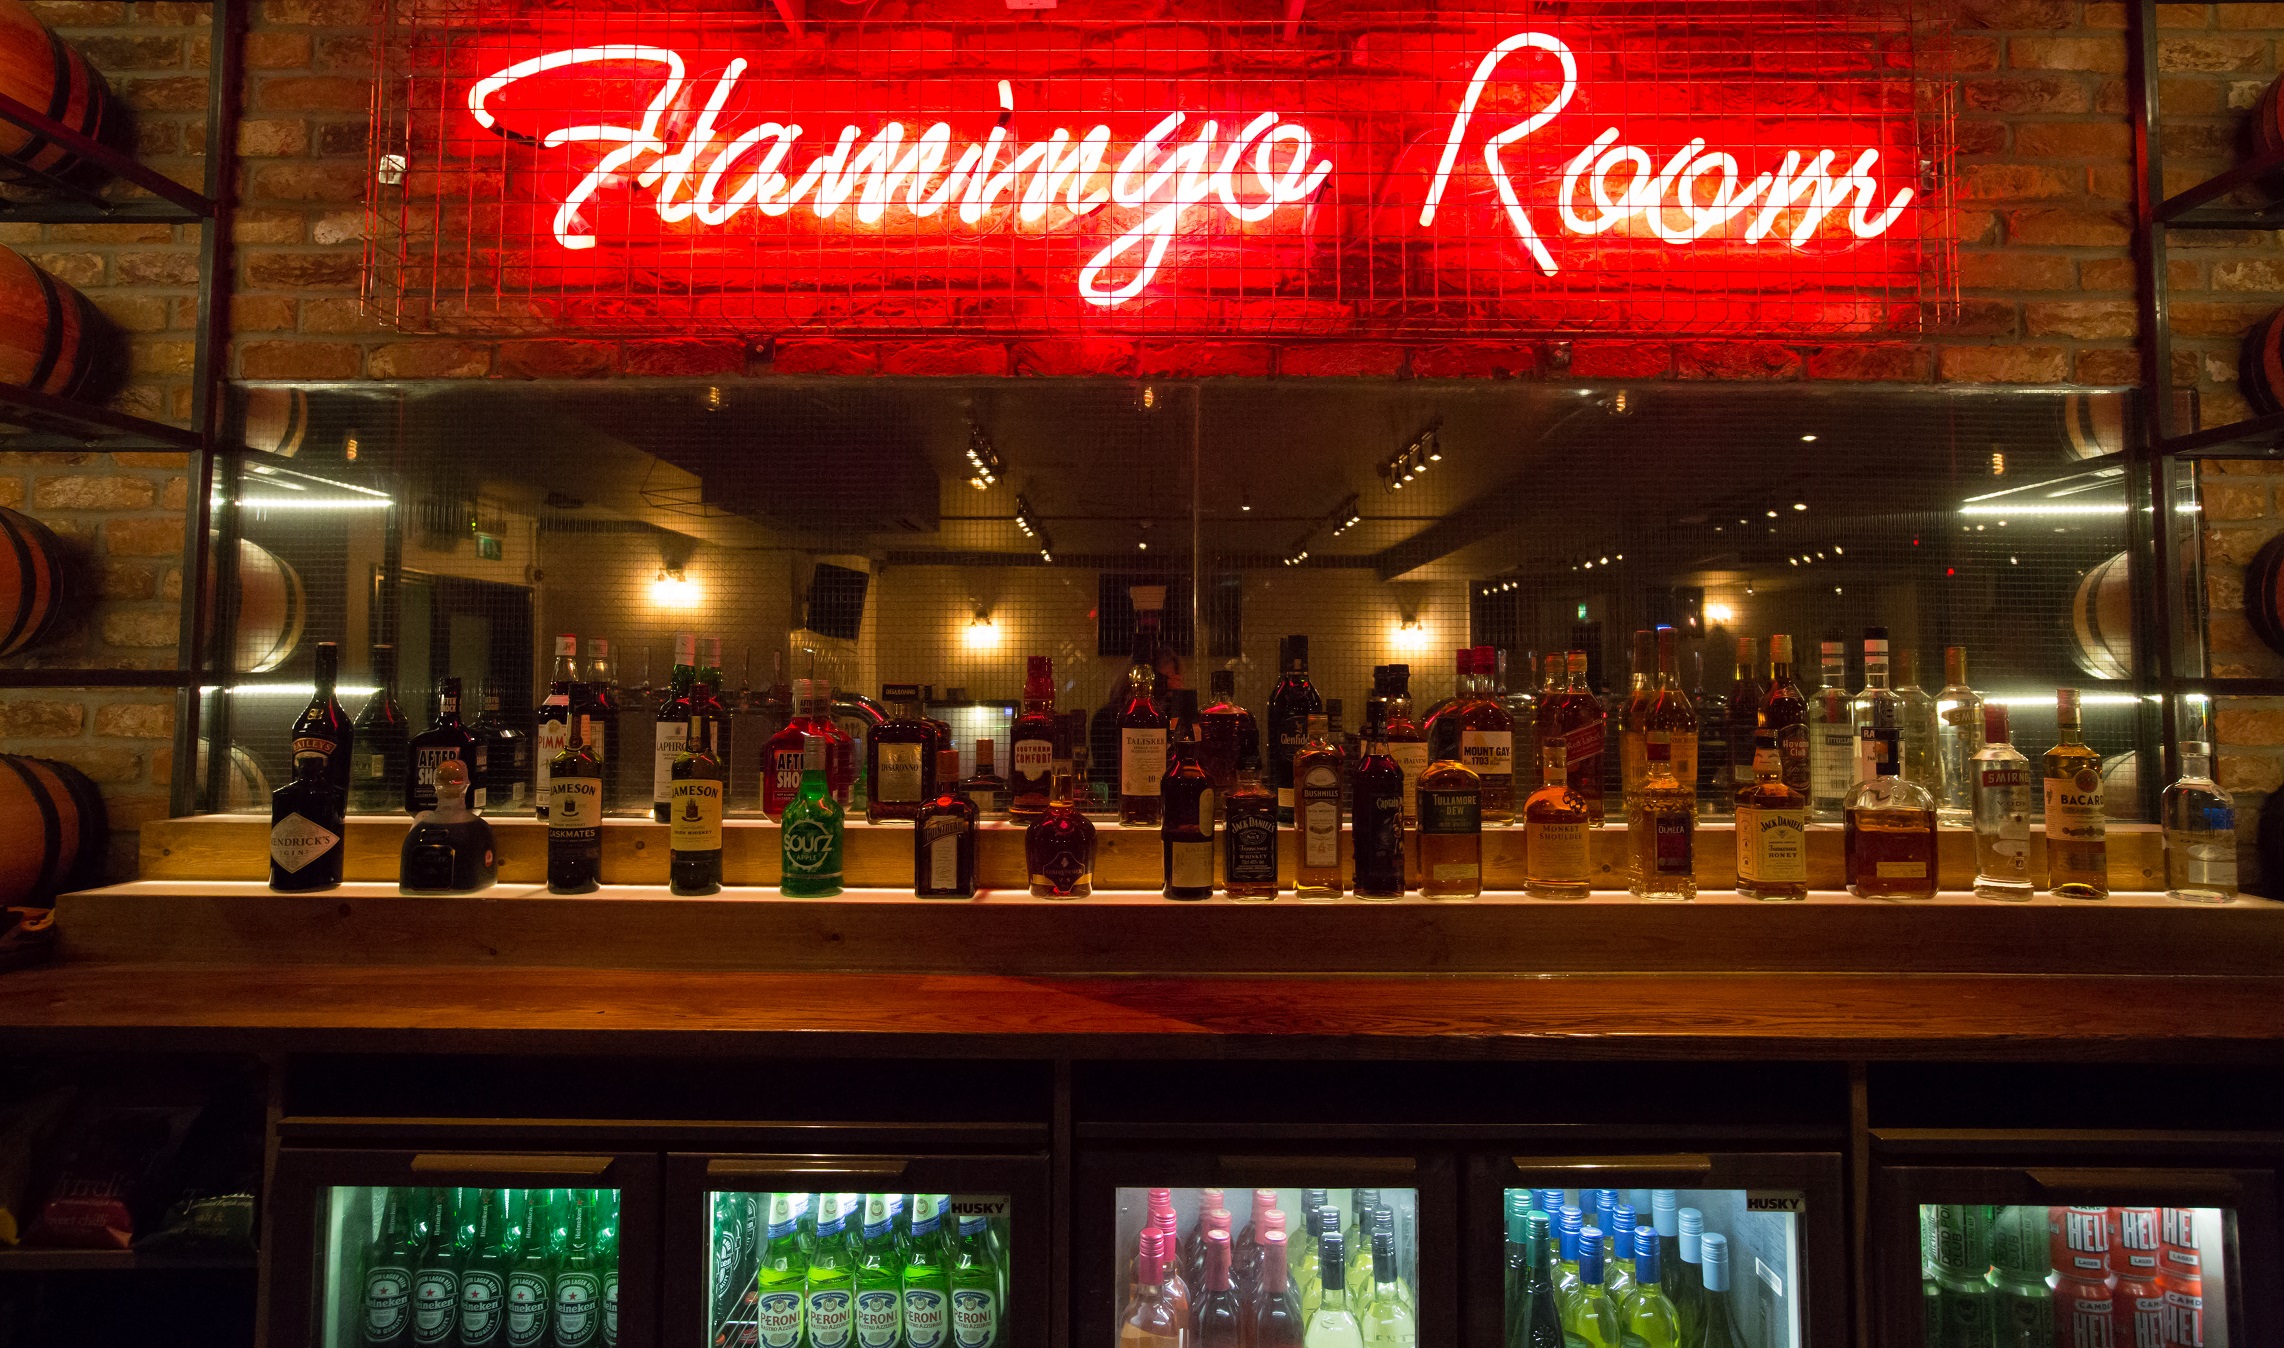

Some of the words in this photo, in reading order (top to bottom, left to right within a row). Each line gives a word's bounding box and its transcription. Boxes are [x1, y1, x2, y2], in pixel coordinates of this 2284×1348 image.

[467, 43, 1334, 306] Flamingo
[1418, 31, 1915, 277] Room
[538, 733, 566, 749] PIMM'
[1126, 737, 1165, 745] TALISKER
[1280, 733, 1310, 745] Glenfidd
[657, 741, 687, 752] LAPHRO
[1464, 747, 1494, 756] MOUNT
[1495, 747, 1510, 756] GAY
[777, 753, 804, 770] AFT
[1471, 757, 1489, 765] 1703
[881, 763, 919, 772] DISARONNO
[776, 771, 801, 788] SHO
[1988, 772, 2029, 784] SMIRNO
[550, 783, 596, 797] JAMESON
[671, 785, 719, 799] JAMESON
[1303, 789, 1339, 798] BUSHMILLS
[1433, 793, 1477, 806] TULLAMORE
[1997, 800, 2028, 808] VODK
[1446, 806, 1465, 815] DEW
[1231, 820, 1248, 834] JACK
[1657, 825, 1685, 834] OLMECA
[1760, 819, 1778, 833] JACK
[1777, 815, 1804, 833] DANIEL'S
[550, 829, 596, 838] CASKMATES
[1539, 832, 1583, 841] SHOULDER
[952, 1203, 1004, 1213] HUSKY
[1748, 1199, 1800, 1209] HUSKY
[2169, 1294, 2202, 1306] CAMD
[760, 1310, 800, 1326] PERONI
[811, 1309, 850, 1325] PERONI
[858, 1310, 898, 1325] PERONI
[905, 1309, 942, 1323] PERONI
[954, 1308, 992, 1323] PERONI
[2164, 1304, 2203, 1347] HEL
